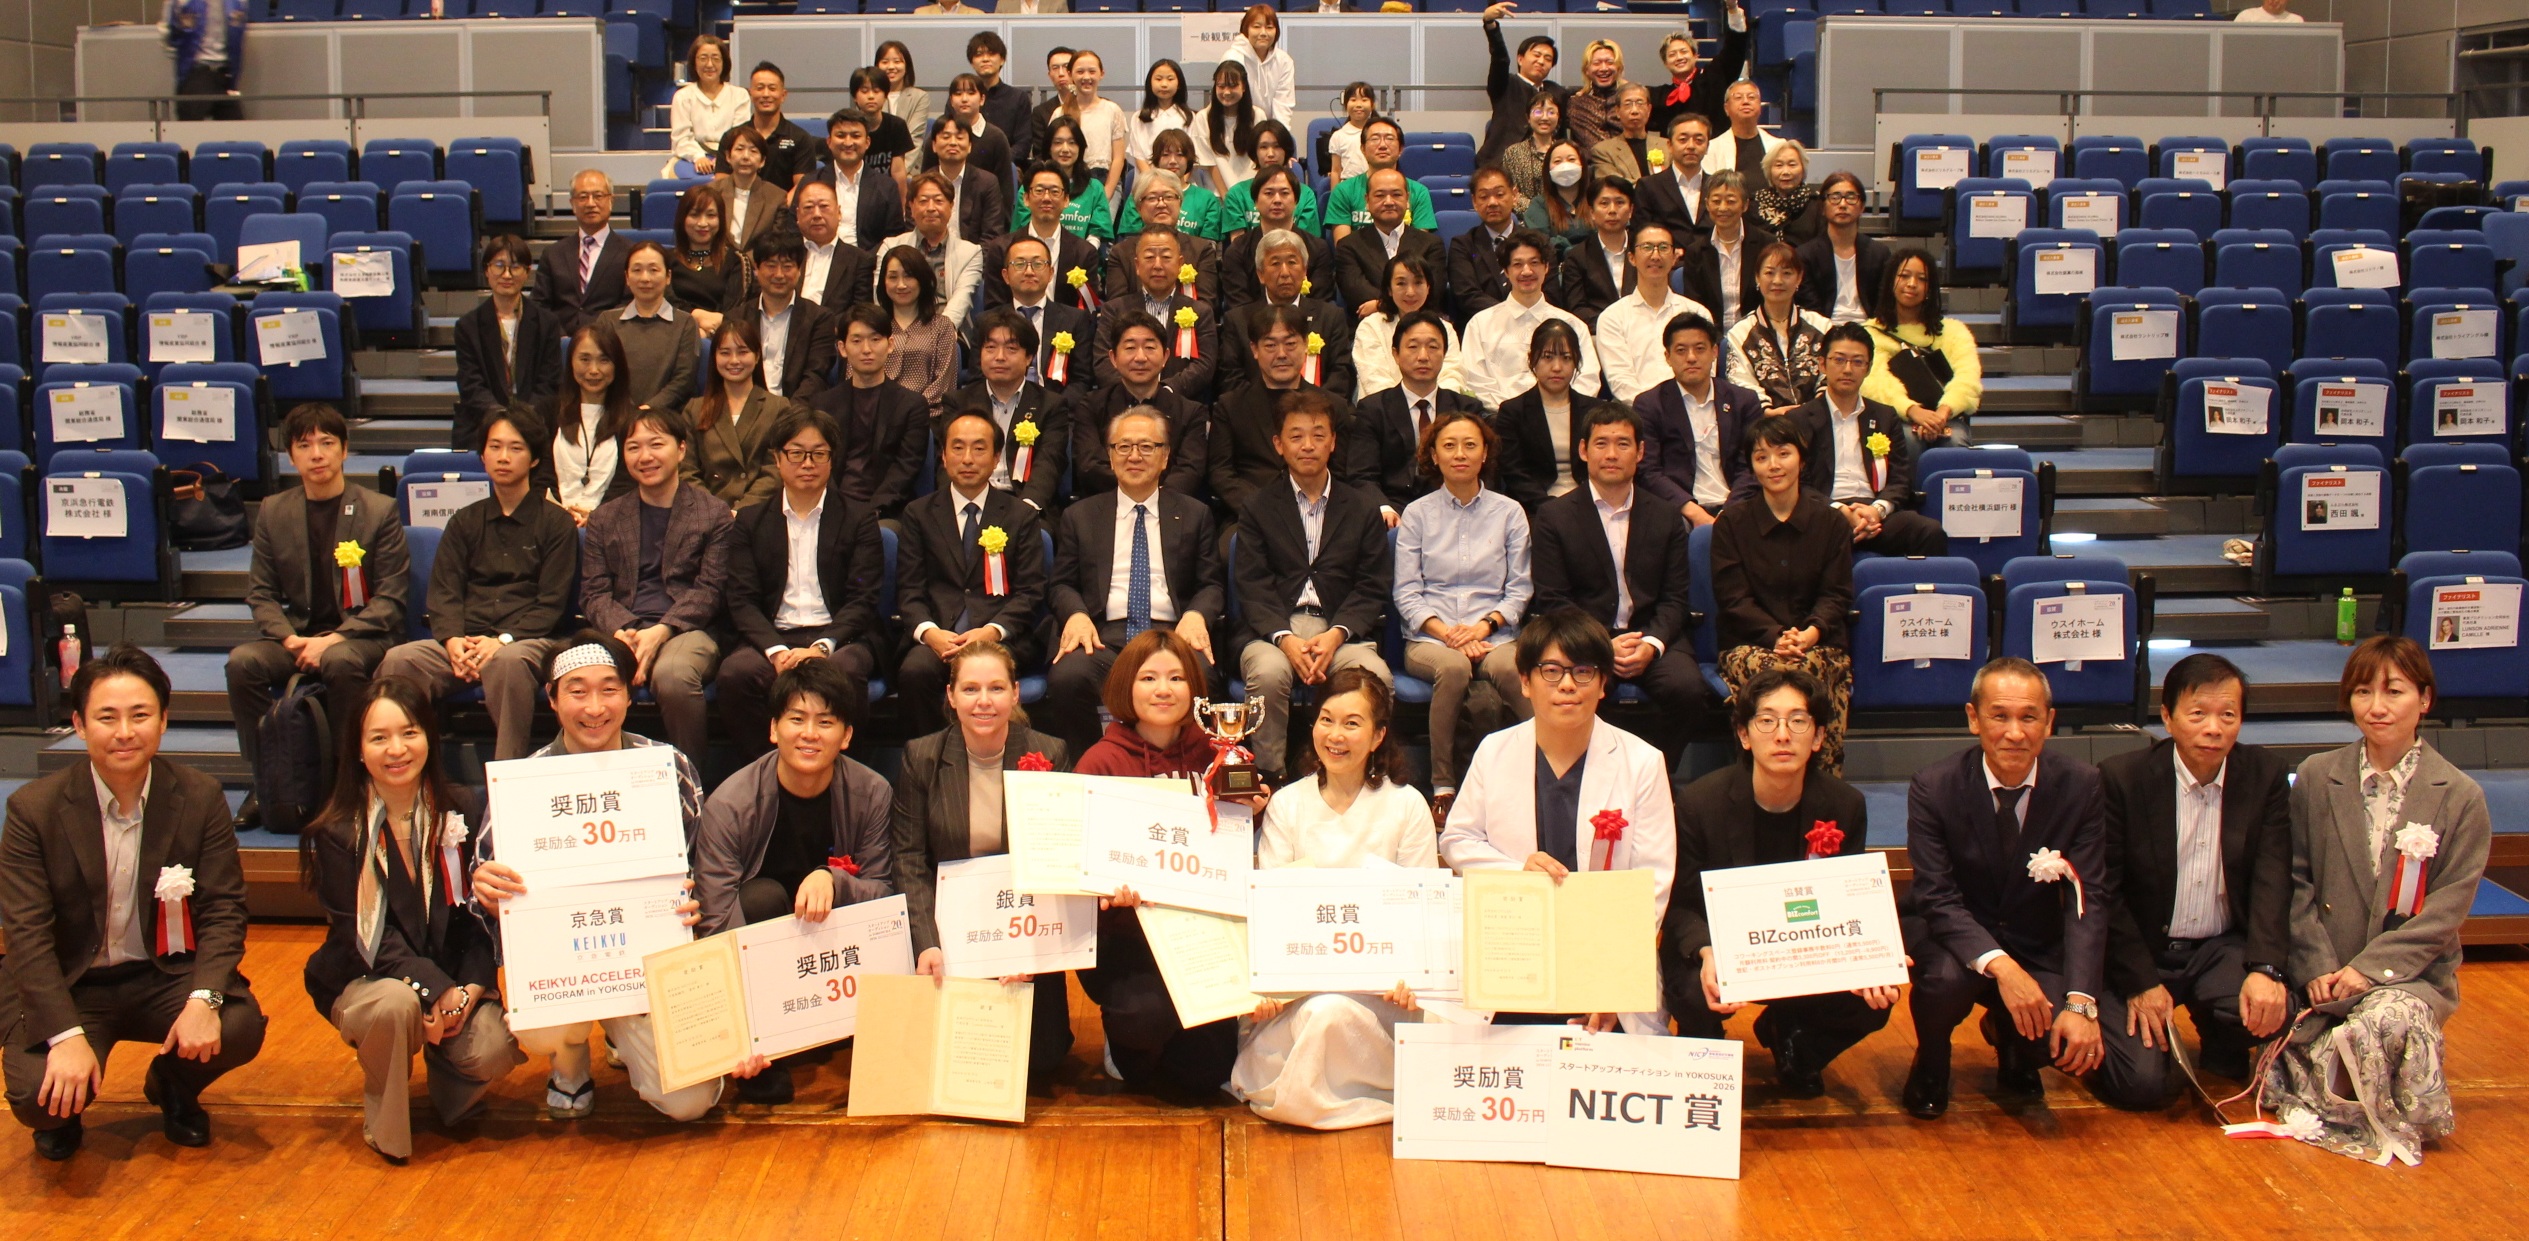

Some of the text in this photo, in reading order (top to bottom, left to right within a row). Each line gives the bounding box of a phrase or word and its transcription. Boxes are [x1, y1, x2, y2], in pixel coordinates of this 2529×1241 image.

[2356, 418, 2369, 426] 和子
[2460, 417, 2474, 425] 岡本
[61, 498, 114, 507] 京浜急行電鉄
[422, 508, 459, 518] 湘南信用
[1948, 503, 2017, 512] 株式会社横浜銀行 様
[65, 509, 112, 518] 株式会社 様
[2330, 509, 2347, 518] 西田
[1899, 617, 1953, 628] ウスイホーム
[1901, 628, 1949, 638] 株式会社 様
[2051, 618, 2105, 629] ウスイホーム
[2053, 629, 2102, 640] 株式会社 様
[550, 790, 623, 818] 奨励賞
[533, 819, 646, 852] 奨励金 30万円
[1147, 821, 1190, 848] 金賞
[1108, 848, 1228, 883] 奨励金 100万円
[995, 889, 1036, 911] 銀賞
[1784, 886, 1814, 898] 協賛賞
[570, 907, 625, 929] 京急賞
[1316, 903, 1360, 925] 銀賞
[1787, 909, 1818, 918] BIZcomfort
[966, 914, 1063, 944] 奨励金 50万円
[1748, 919, 1863, 946] BIZcomfort賞
[573, 932, 626, 951] KEIKYU
[1285, 931, 1394, 956] 奨励金 50万円
[796, 944, 862, 979] 奨励賞
[528, 968, 646, 991] KEIKYU ACCELERA
[534, 982, 647, 1002] PROGRAM in YOKOSUK
[782, 993, 823, 1015] 奨励金
[1452, 1065, 1524, 1090] 奨励賞
[1559, 1061, 1734, 1082] スタートアップオーディション in YOKOSUKA
[1713, 1082, 1735, 1091] 2026
[1432, 1096, 1545, 1123] 奨励金 30万円
[1569, 1088, 1723, 1131] NICT 賞
